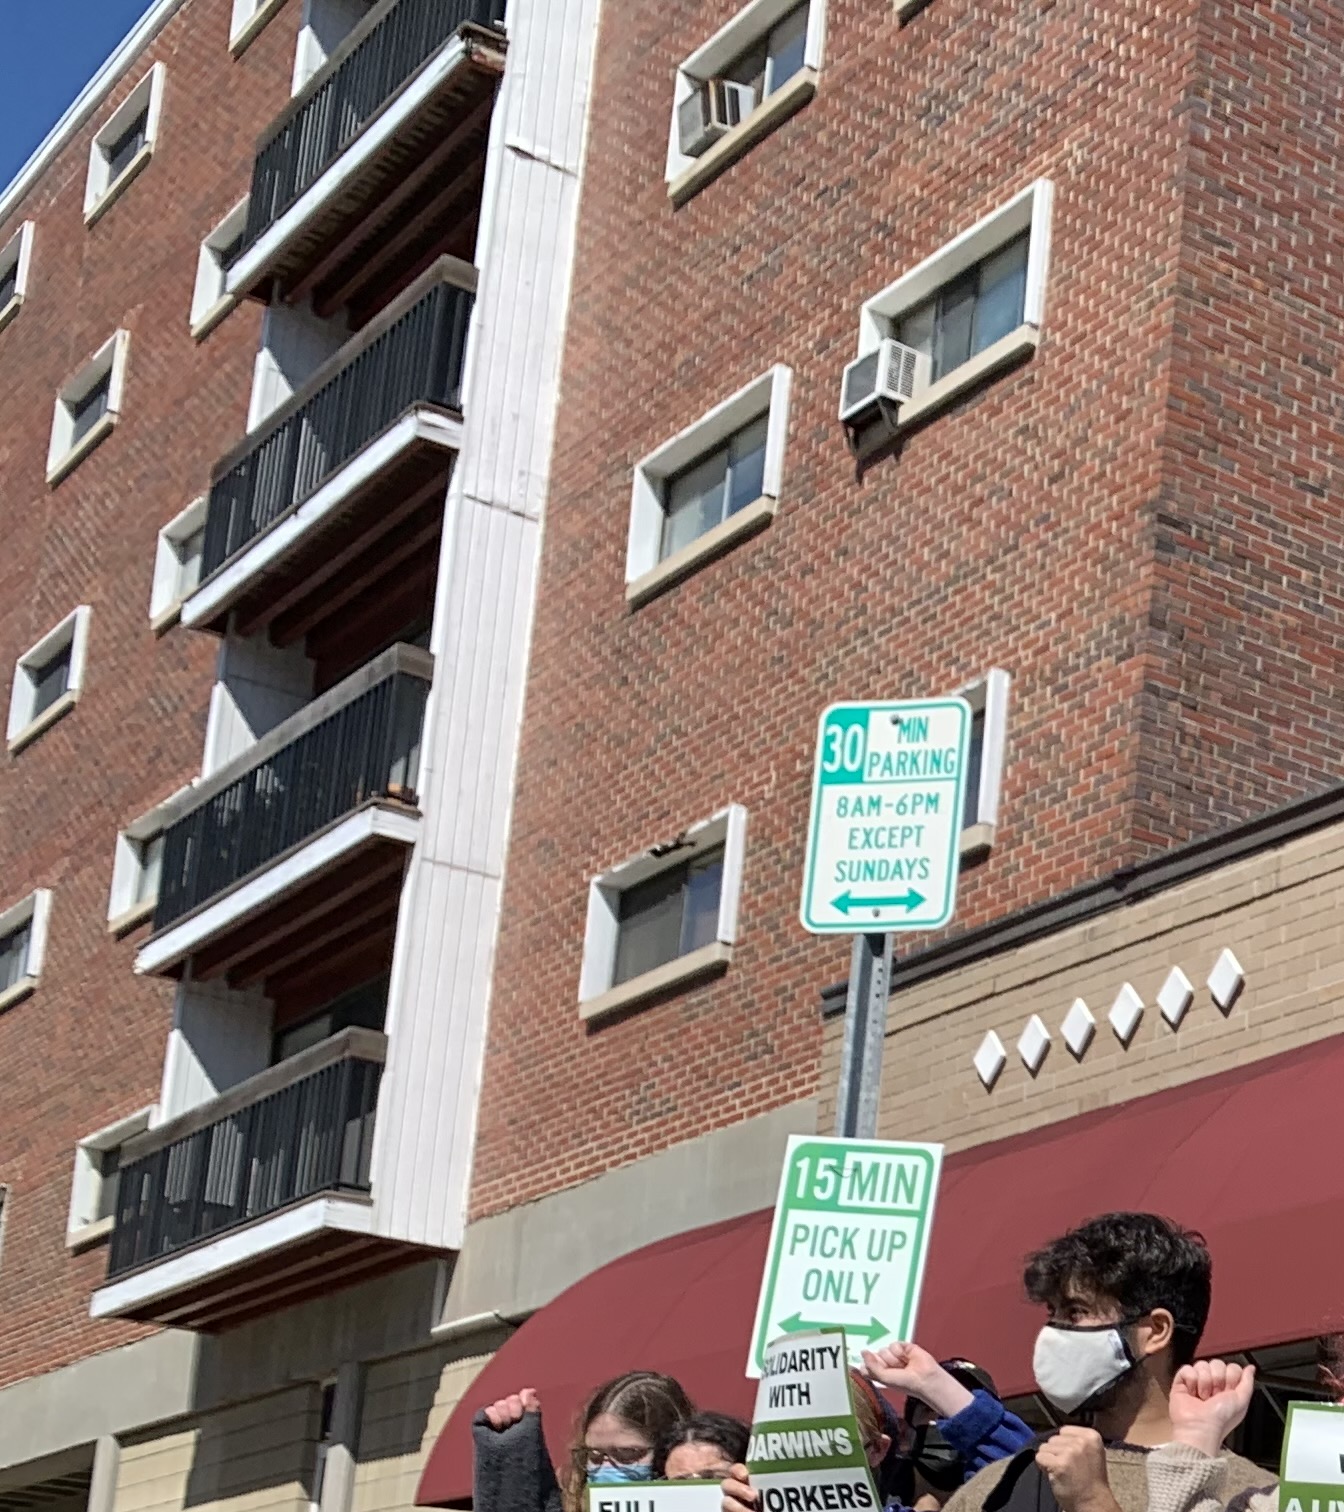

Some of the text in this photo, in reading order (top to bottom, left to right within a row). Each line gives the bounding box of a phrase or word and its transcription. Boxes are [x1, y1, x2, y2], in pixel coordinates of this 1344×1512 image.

[897, 716, 929, 744] MIN
[823, 724, 864, 772] 30
[868, 748, 956, 778] PARKING
[836, 793, 940, 818] 8AM-6PM
[848, 825, 925, 850] EXCEPT
[834, 857, 930, 883] SUNDAYS
[796, 1156, 918, 1204] 15 MIN
[789, 1223, 907, 1262] PICK UP
[802, 1268, 880, 1305] ONLY
[761, 1345, 840, 1380] SOLIDARITY
[769, 1382, 811, 1408] WITH
[746, 1427, 853, 1462] DARWIN'S
